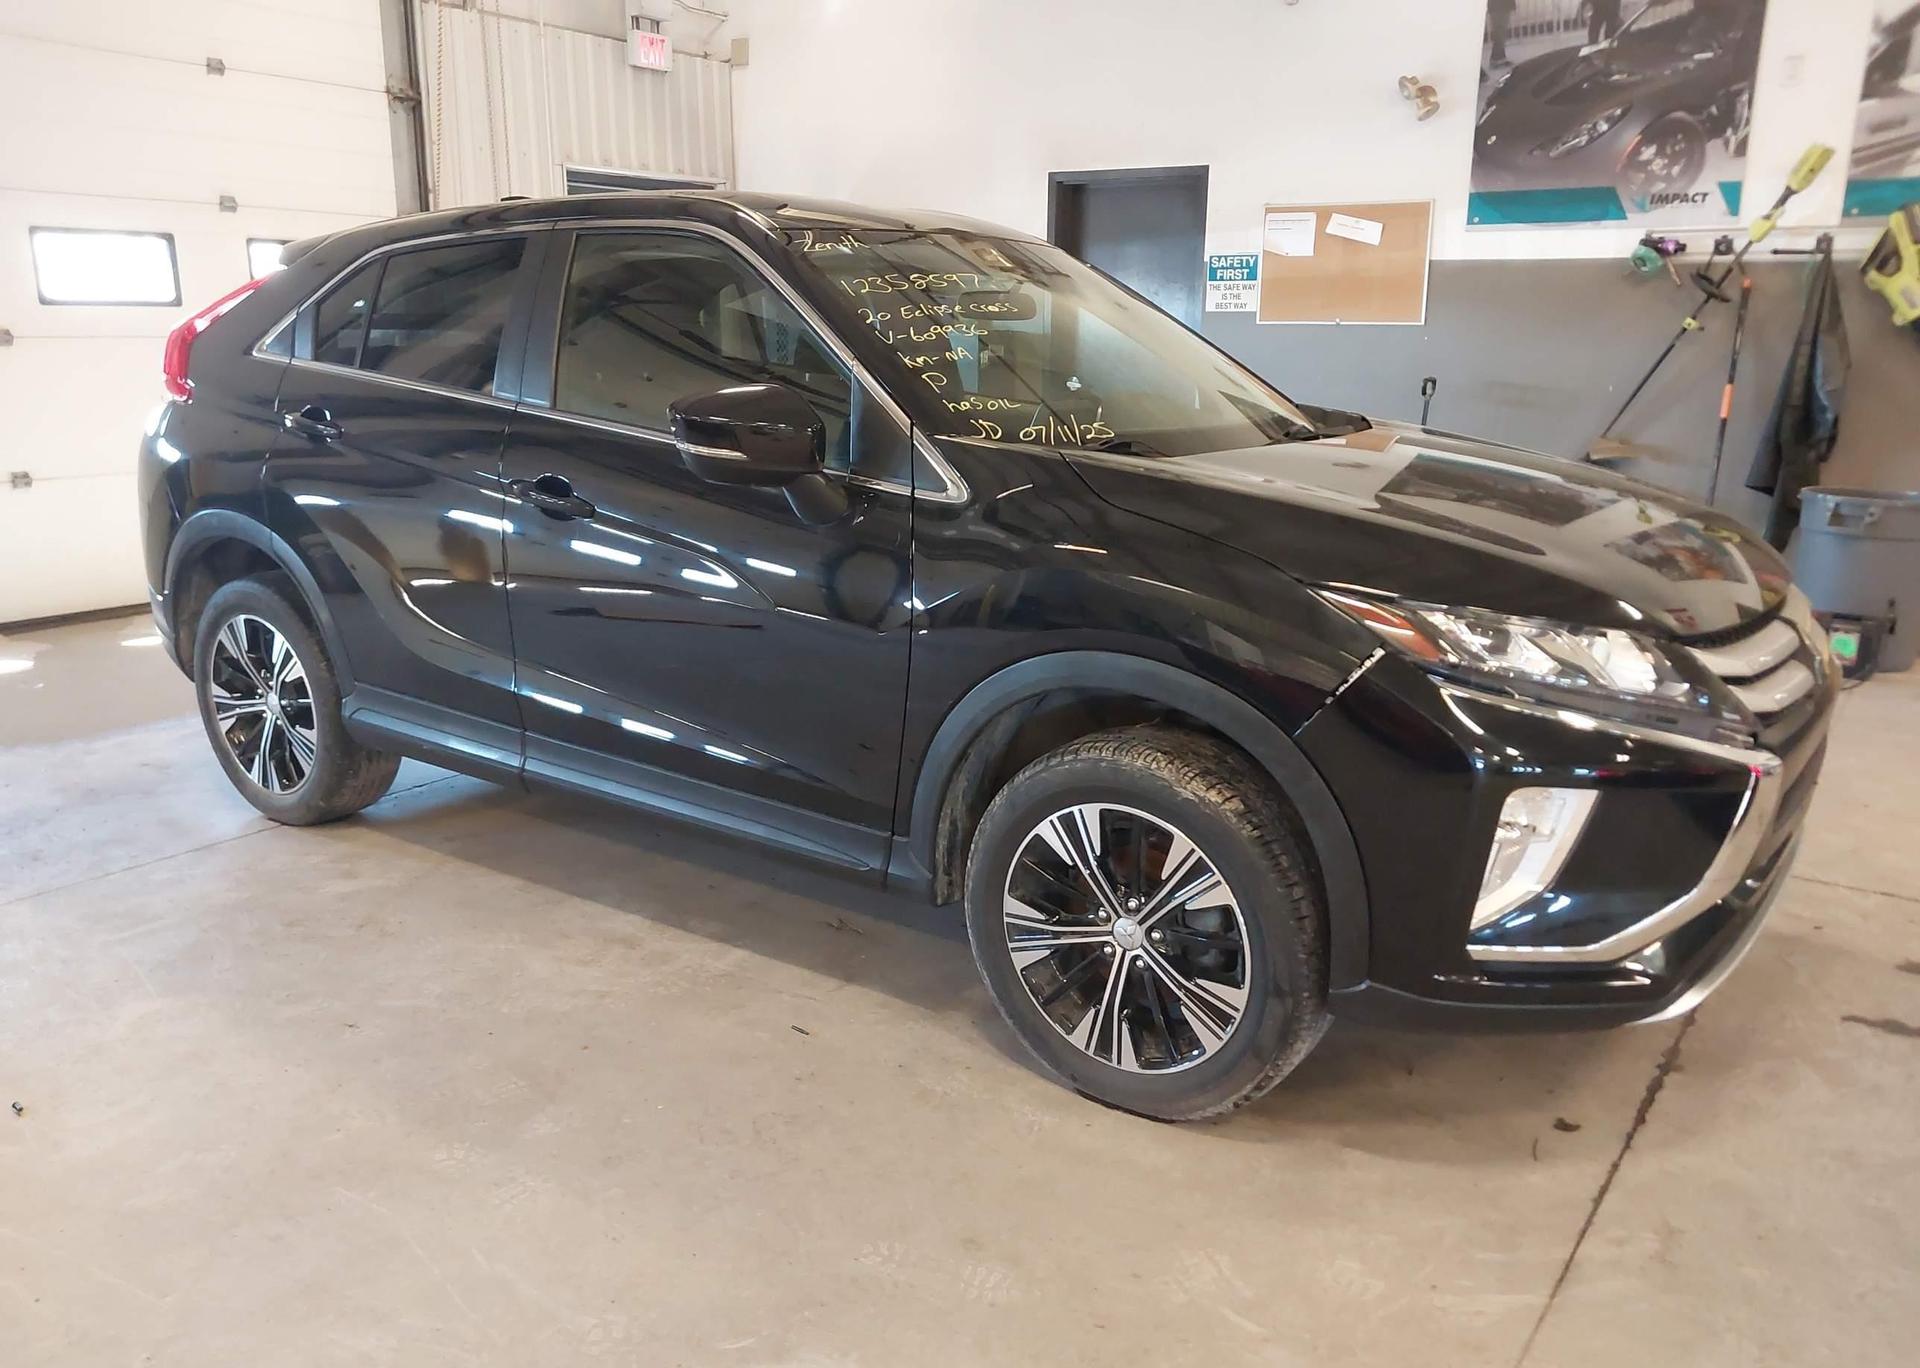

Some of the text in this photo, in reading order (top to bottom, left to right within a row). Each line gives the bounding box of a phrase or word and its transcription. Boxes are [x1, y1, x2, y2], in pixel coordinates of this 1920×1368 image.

[639, 34, 666, 67] EXIT
[1649, 192, 1709, 205] IMPACT
[1211, 256, 1256, 268] SAFETY
[1216, 269, 1250, 280] FIRST
[840, 273, 980, 297] 12358597
[1222, 293, 1242, 301] IS THE
[1215, 302, 1248, 310] BEST WAY
[858, 308, 892, 324] 20
[900, 303, 966, 320] Eclipse
[1019, 414, 1115, 446] 07/11/25
